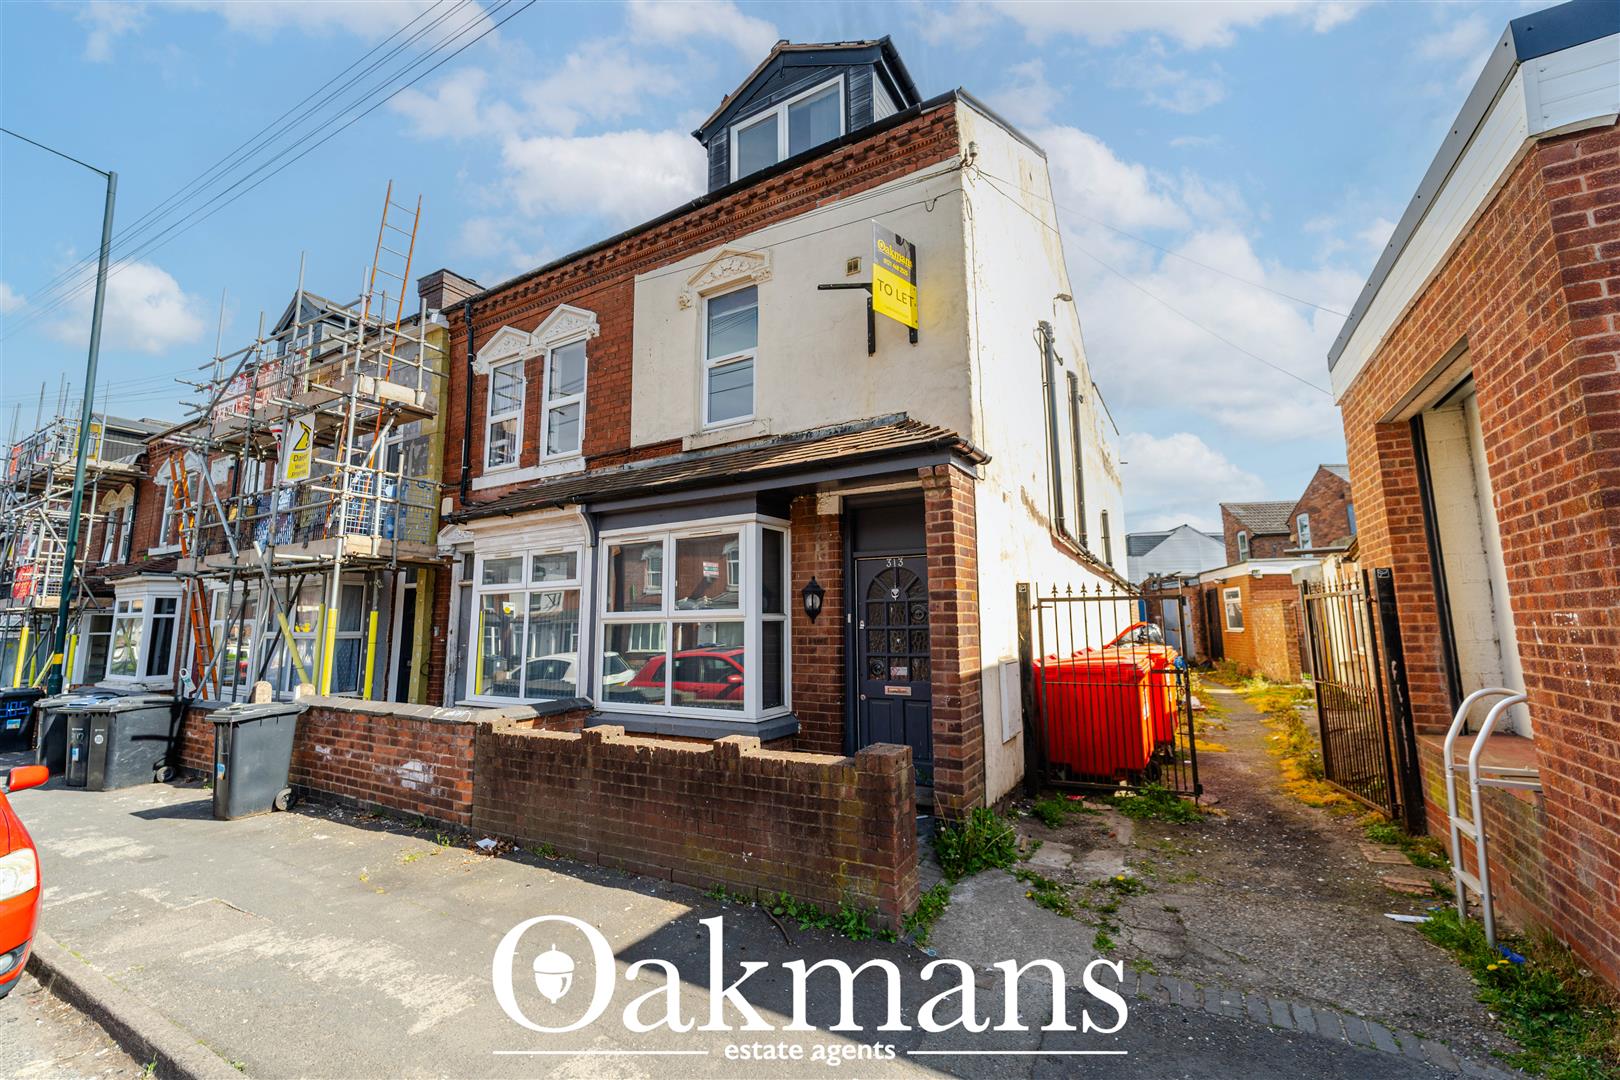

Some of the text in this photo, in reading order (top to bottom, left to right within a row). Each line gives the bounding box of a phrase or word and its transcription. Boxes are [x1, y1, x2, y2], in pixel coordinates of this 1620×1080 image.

[877, 239, 913, 269] Oakmans
[877, 278, 914, 307] TO LET
[886, 557, 904, 567] 313
